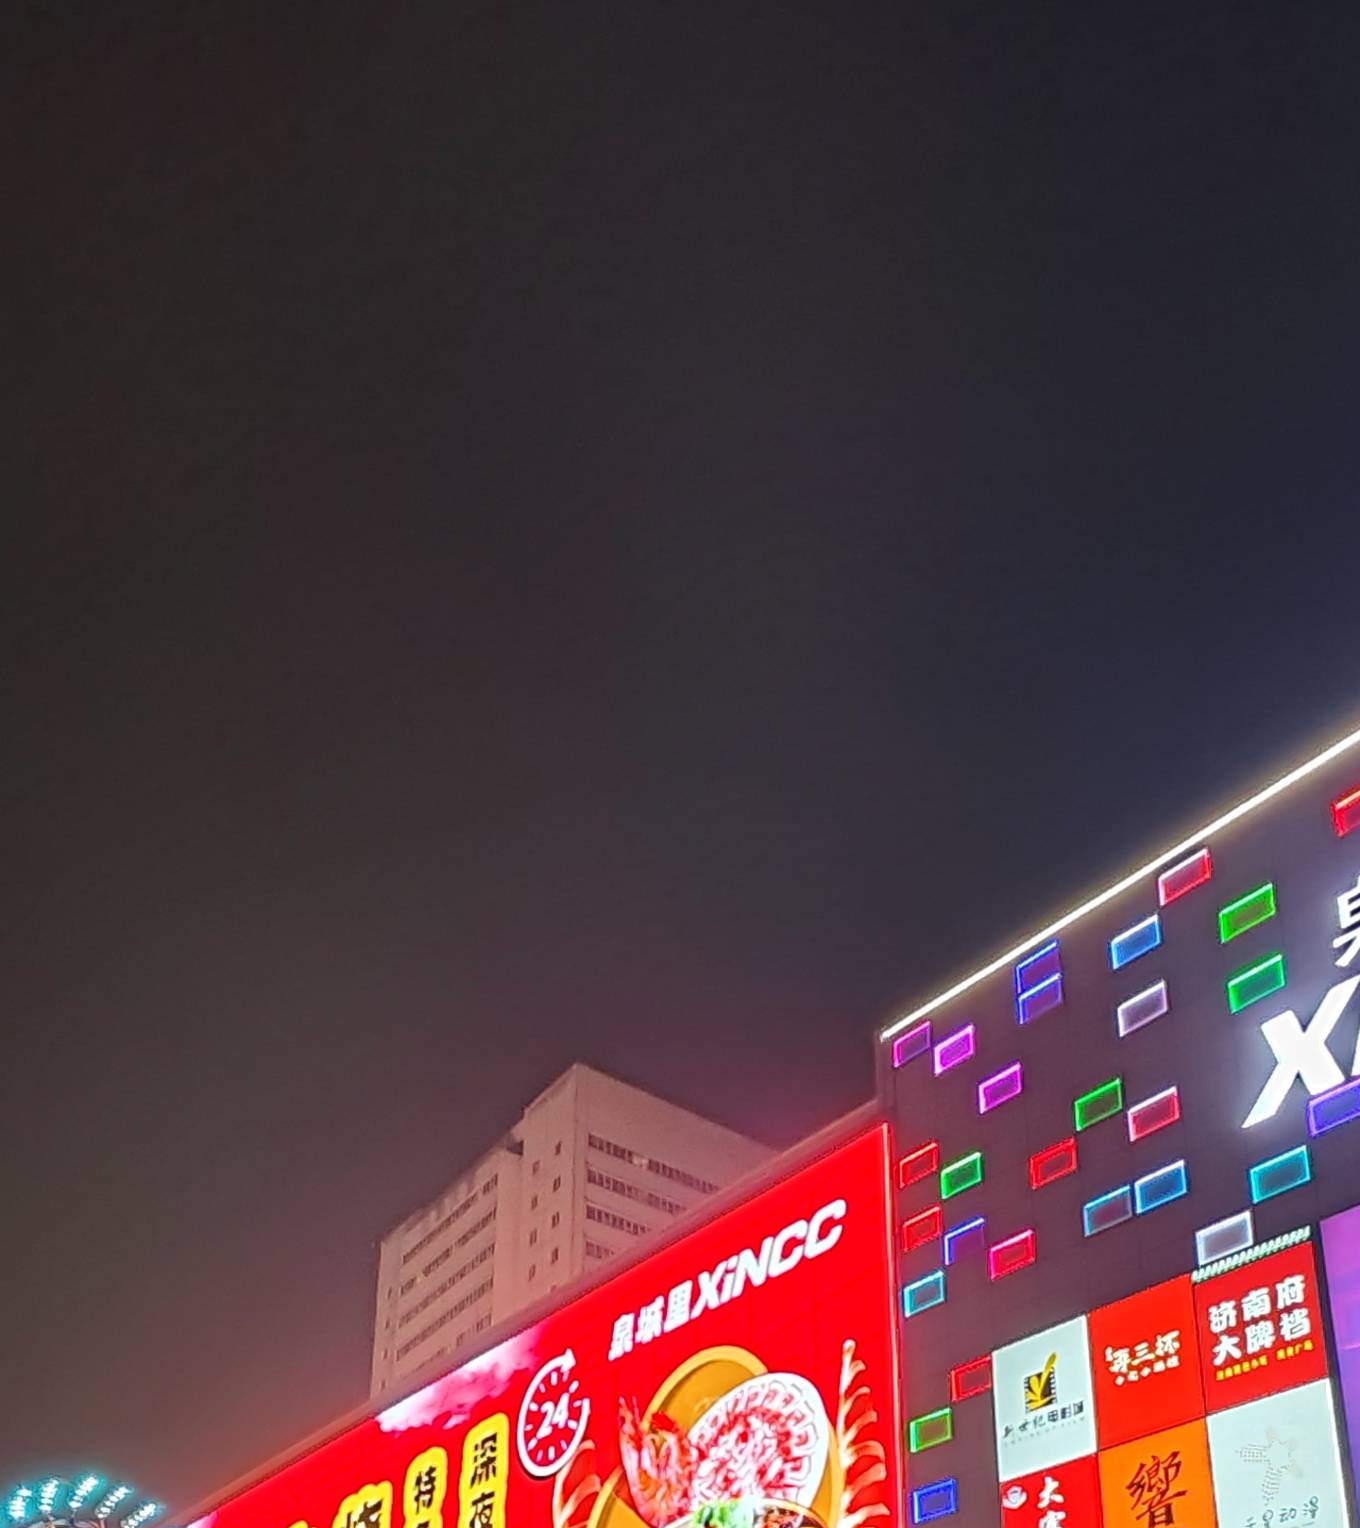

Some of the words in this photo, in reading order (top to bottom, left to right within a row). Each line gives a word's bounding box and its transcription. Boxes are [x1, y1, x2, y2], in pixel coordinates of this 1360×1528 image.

[1213, 1307, 1312, 1367] 大牌档
[535, 1391, 571, 1441] 24
